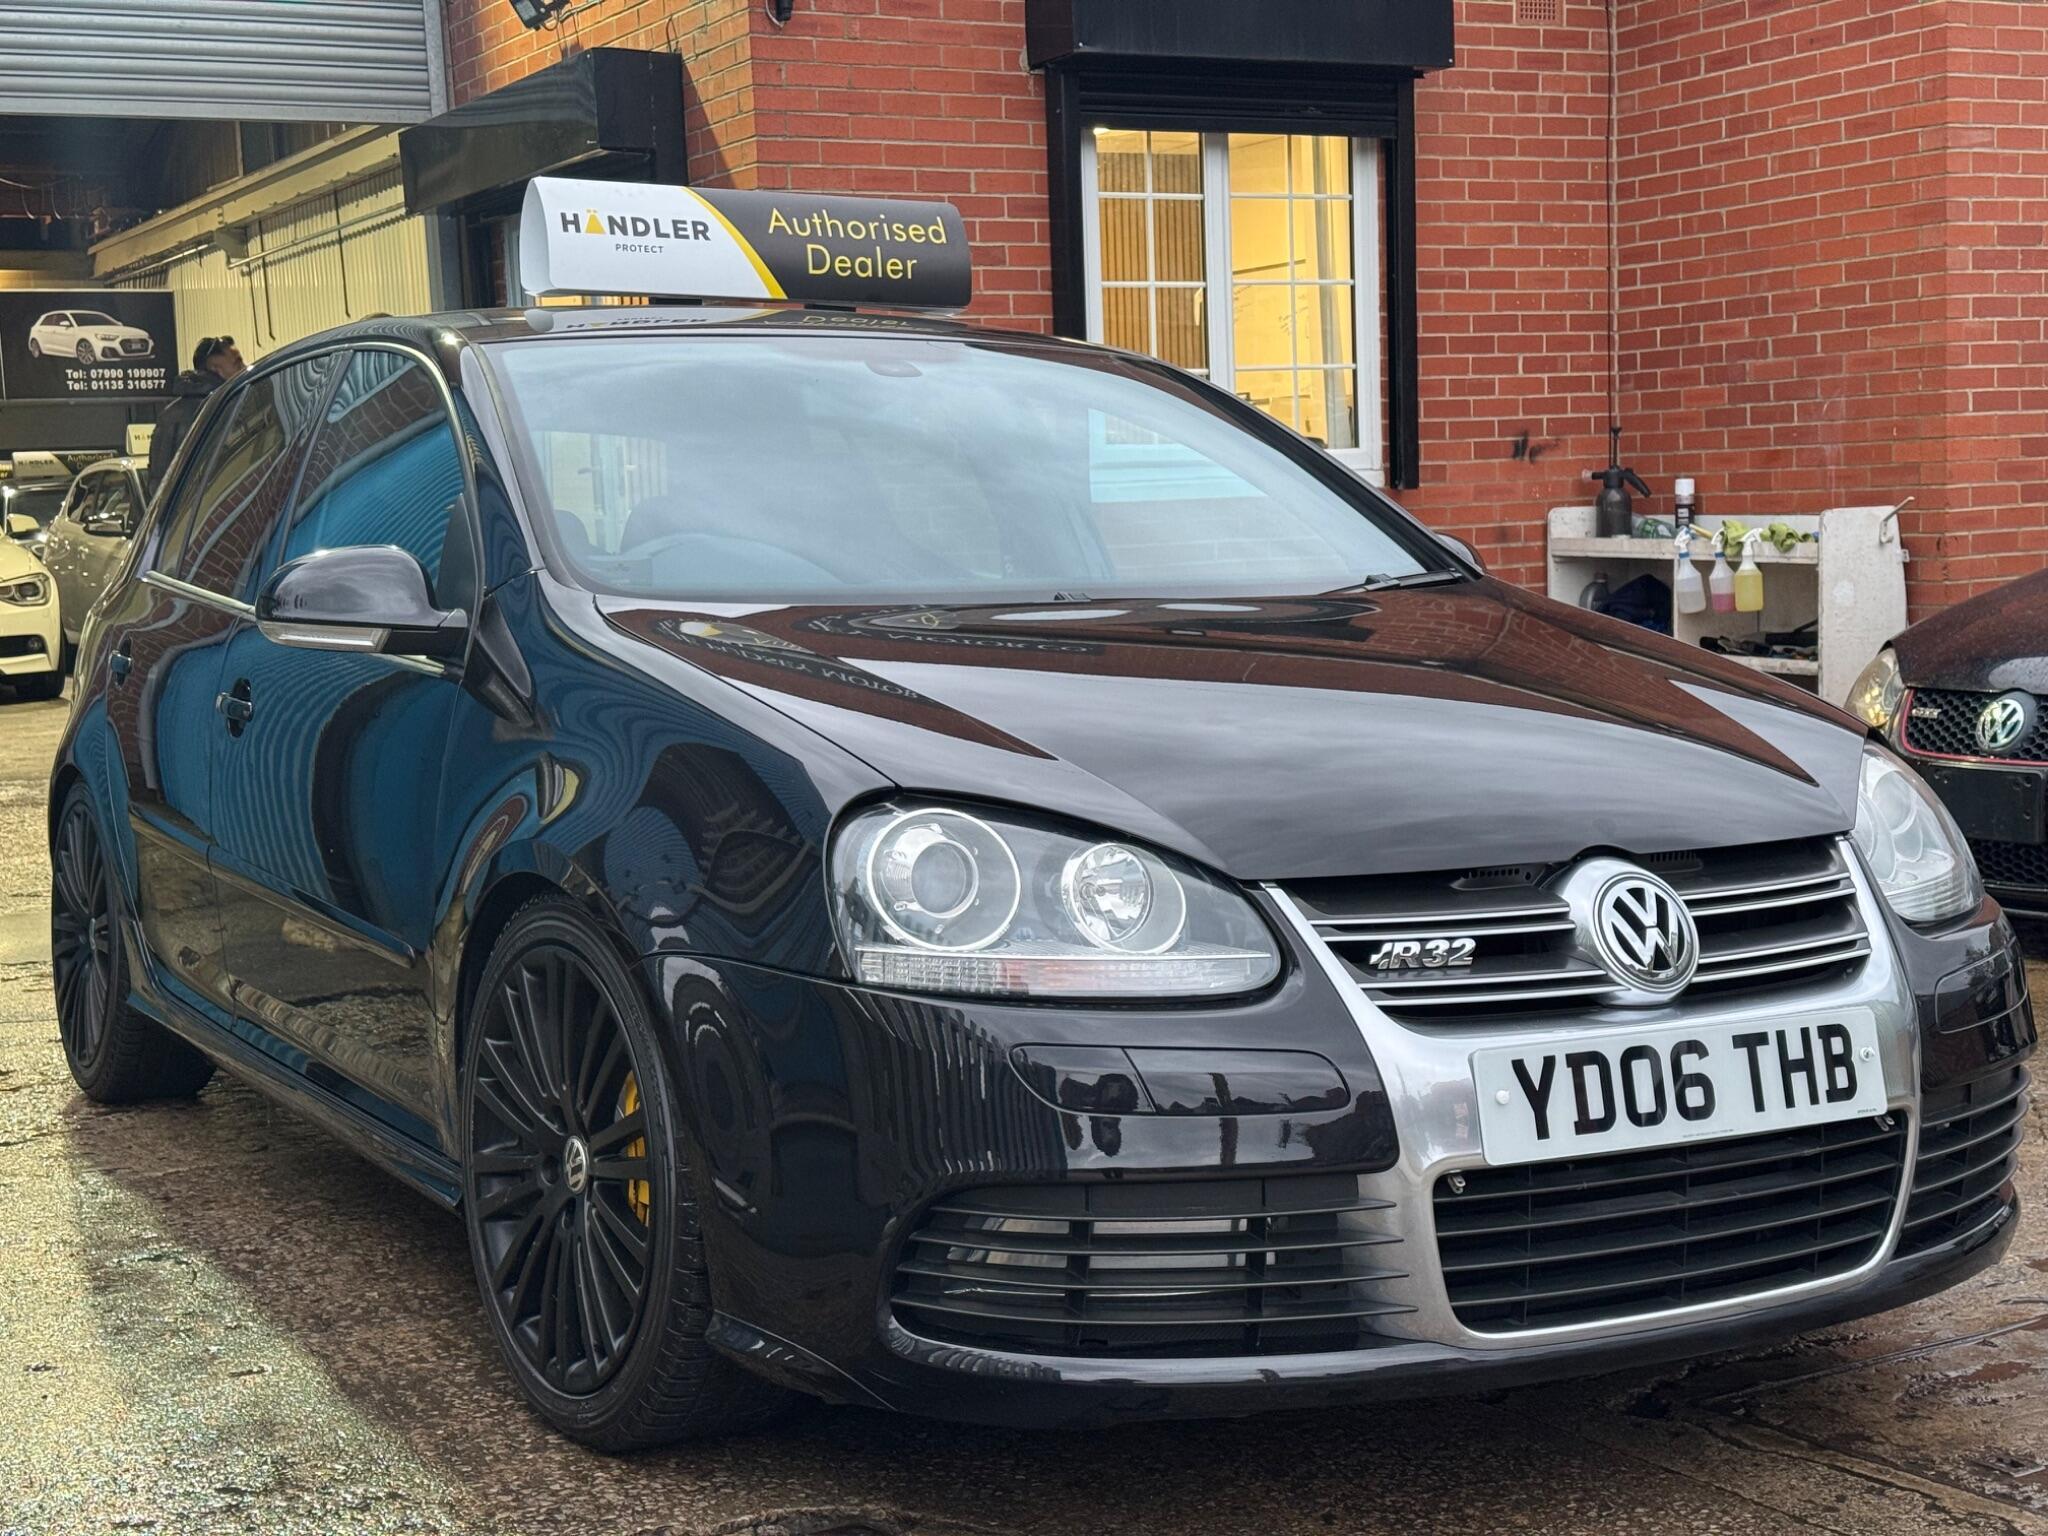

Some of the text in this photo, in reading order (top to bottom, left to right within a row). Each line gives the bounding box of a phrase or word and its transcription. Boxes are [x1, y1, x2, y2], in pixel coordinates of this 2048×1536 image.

[560, 208, 711, 241] HÄNDLER
[768, 207, 948, 245] Authorised
[615, 243, 664, 254] PROTECT
[807, 244, 919, 280] Dealer
[65, 368, 166, 379] Tel: 07990 199907
[66, 381, 88, 391] Tel:
[91, 380, 124, 390] 01135
[1370, 937, 1477, 970] R32
[1511, 1022, 1859, 1141] YD06 THB
